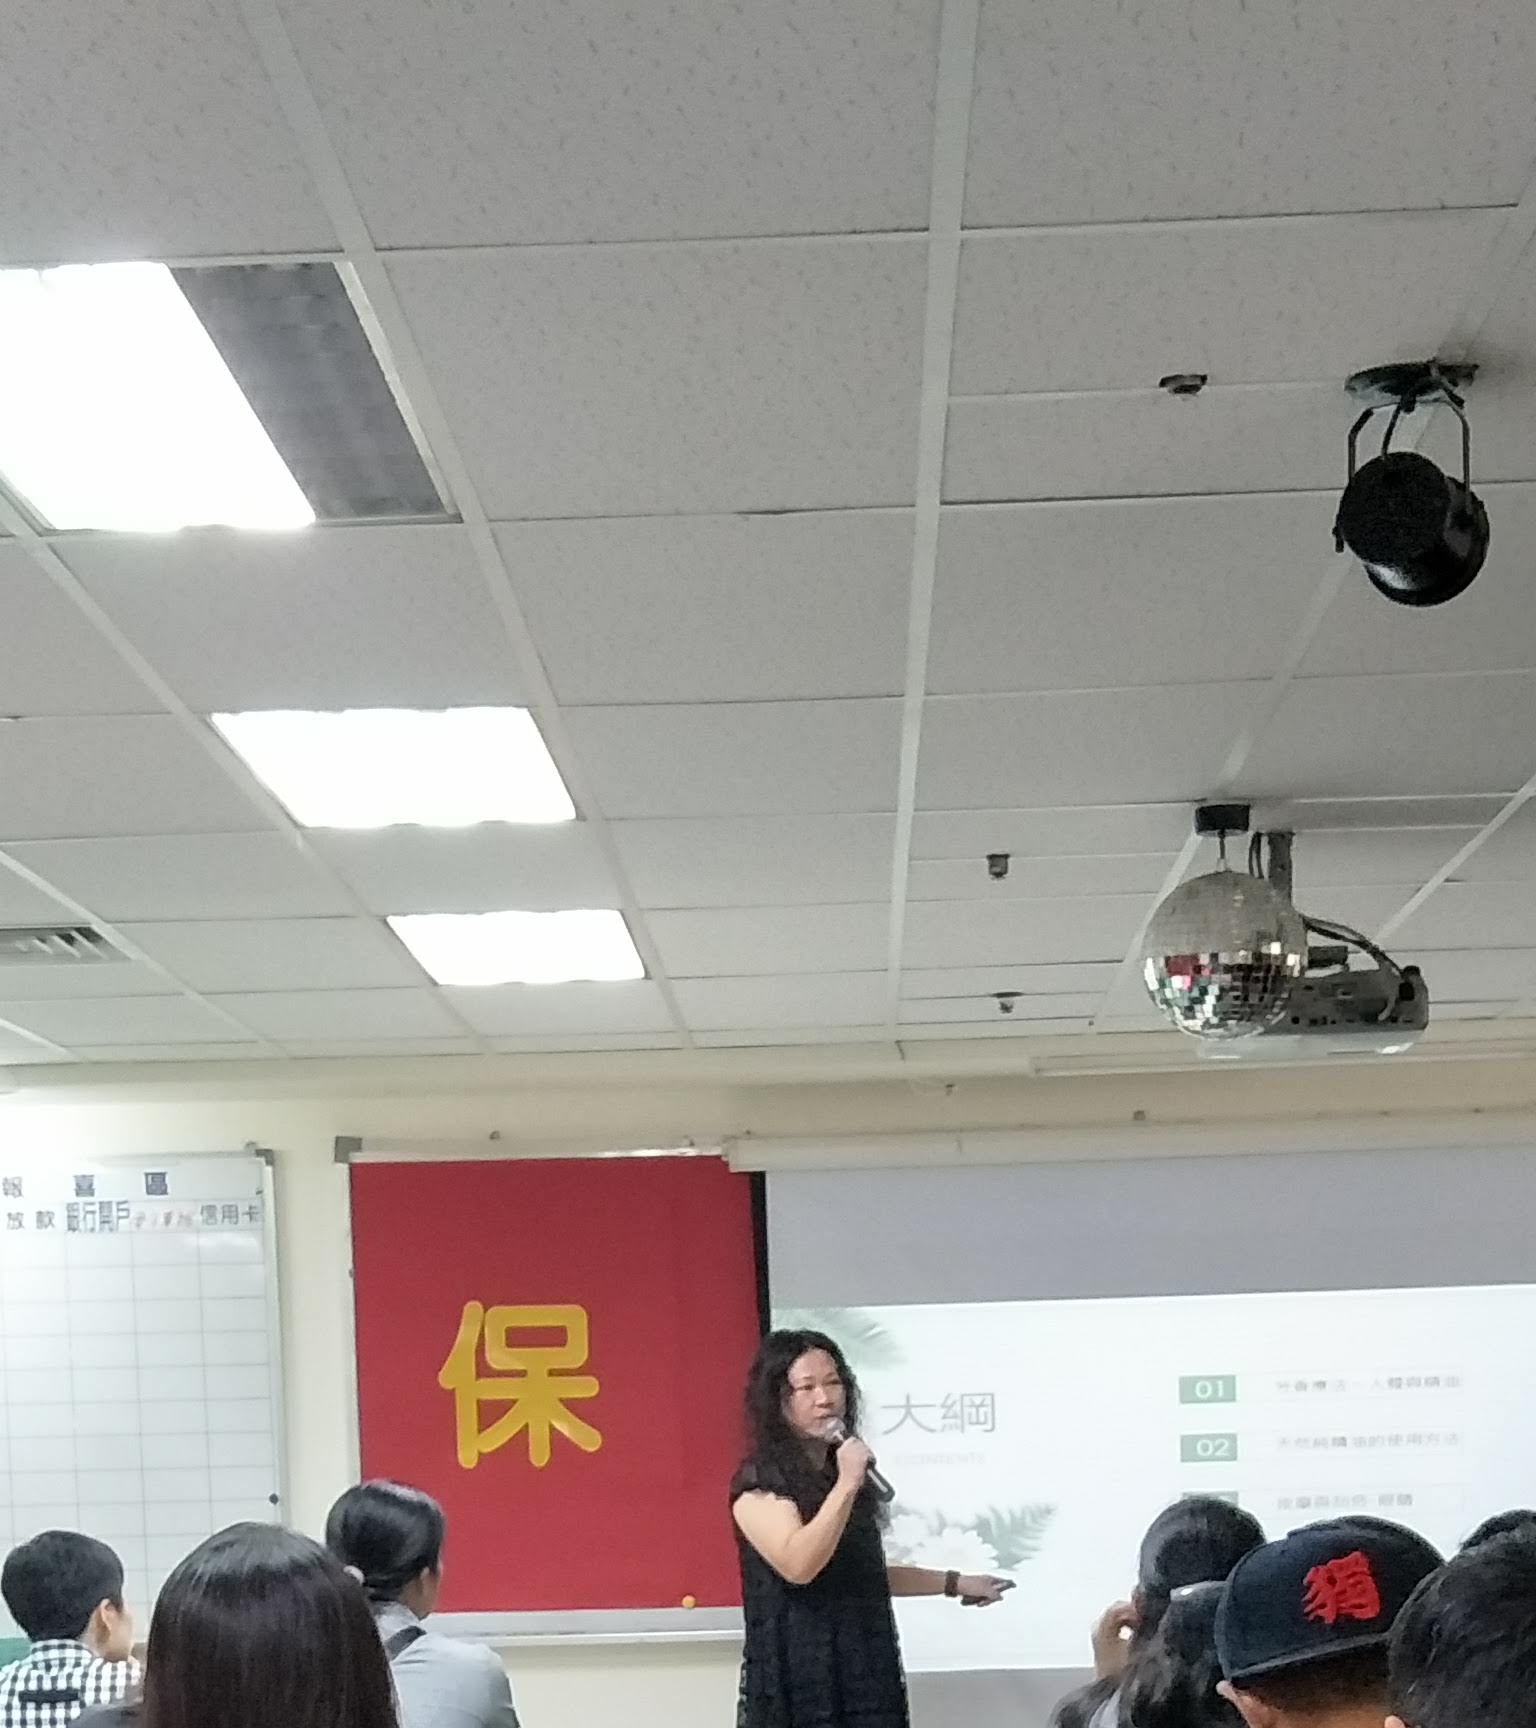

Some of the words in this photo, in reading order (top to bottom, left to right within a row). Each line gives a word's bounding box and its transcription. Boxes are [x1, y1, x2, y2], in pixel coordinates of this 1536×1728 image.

[200, 1203, 260, 1228] 信用卡
[438, 1300, 603, 1470] 保
[1195, 1380, 1225, 1400] 01
[880, 1392, 997, 1436] 大綱
[1196, 1438, 1230, 1457] 02
